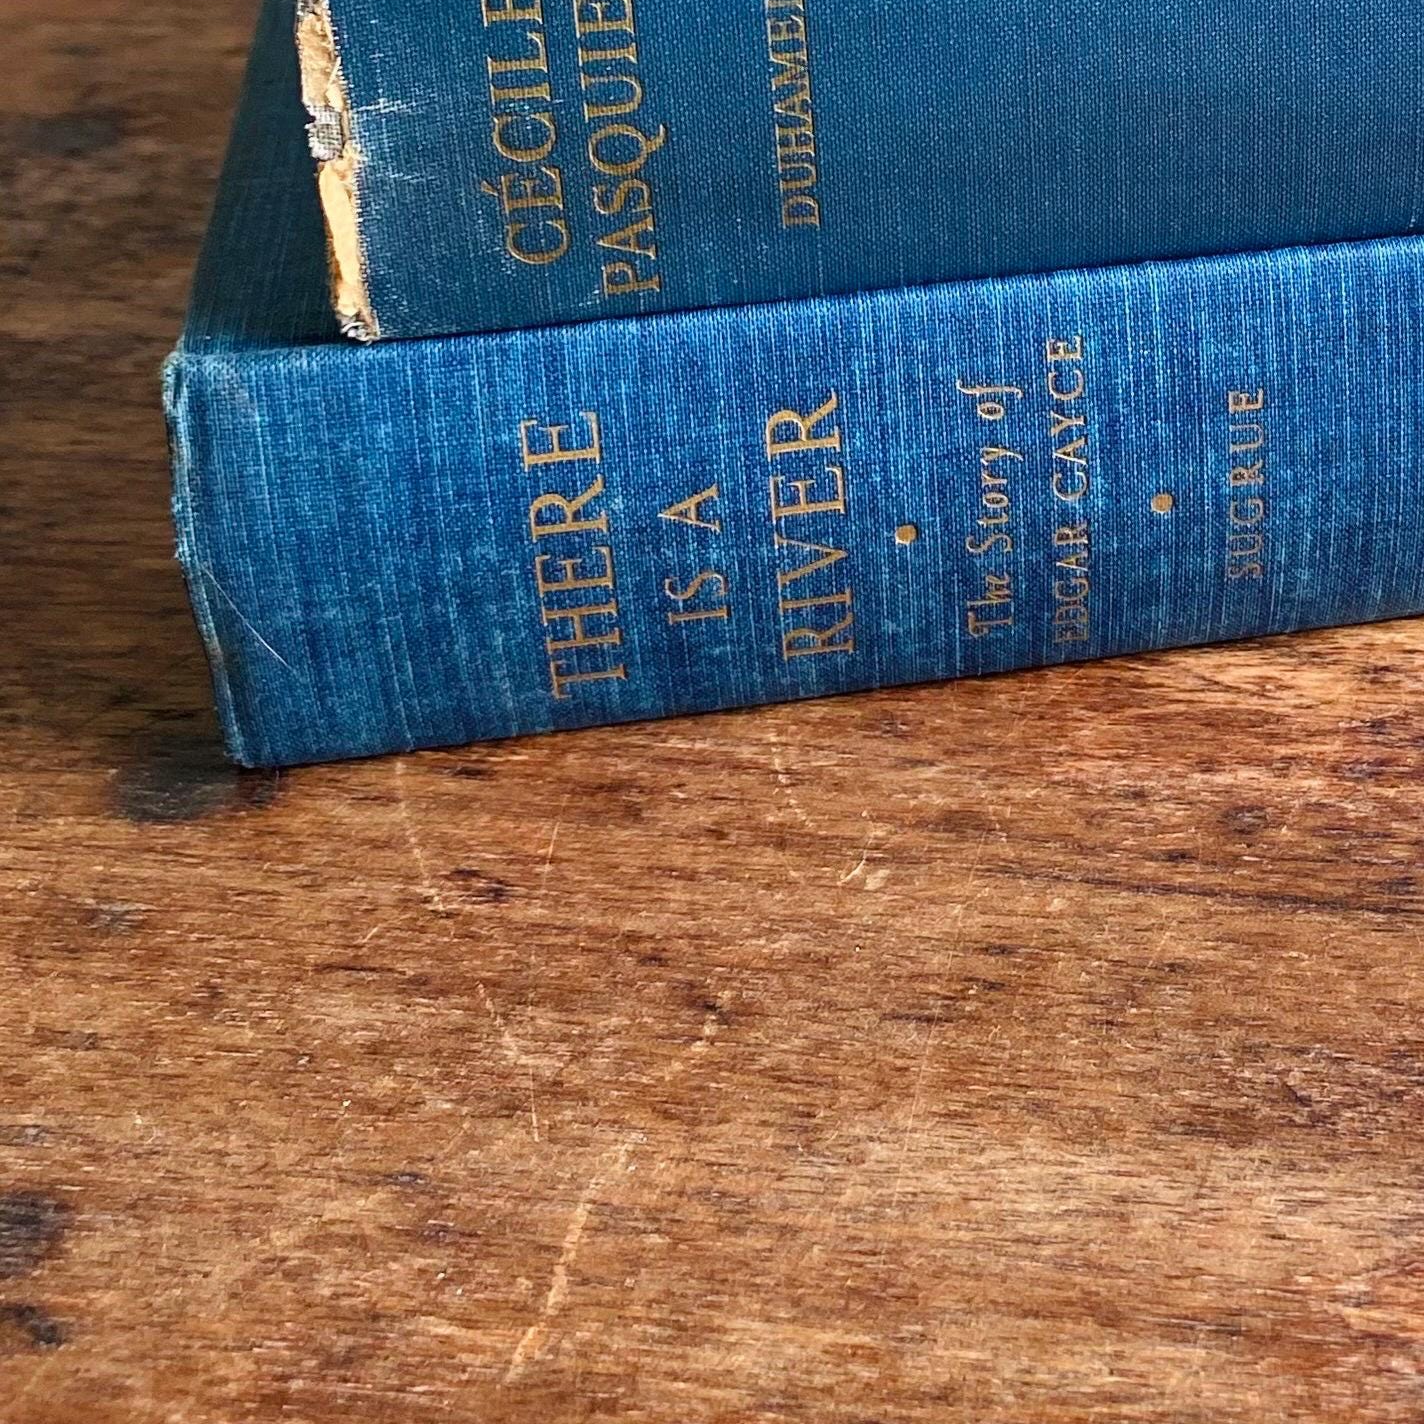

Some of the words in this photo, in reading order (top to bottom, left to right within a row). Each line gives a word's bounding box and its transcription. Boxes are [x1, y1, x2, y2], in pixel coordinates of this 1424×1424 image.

[957, 379, 1023, 421] of
[1046, 334, 1089, 502] CAYCE
[658, 483, 722, 533] A
[766, 388, 856, 661] RIVER
[965, 446, 1023, 555] Story
[1228, 387, 1265, 582] SUGRUE
[520, 411, 628, 700] THERE
[665, 570, 729, 625] IS
[966, 572, 1014, 638] The
[1053, 520, 1089, 645] EDGAR
